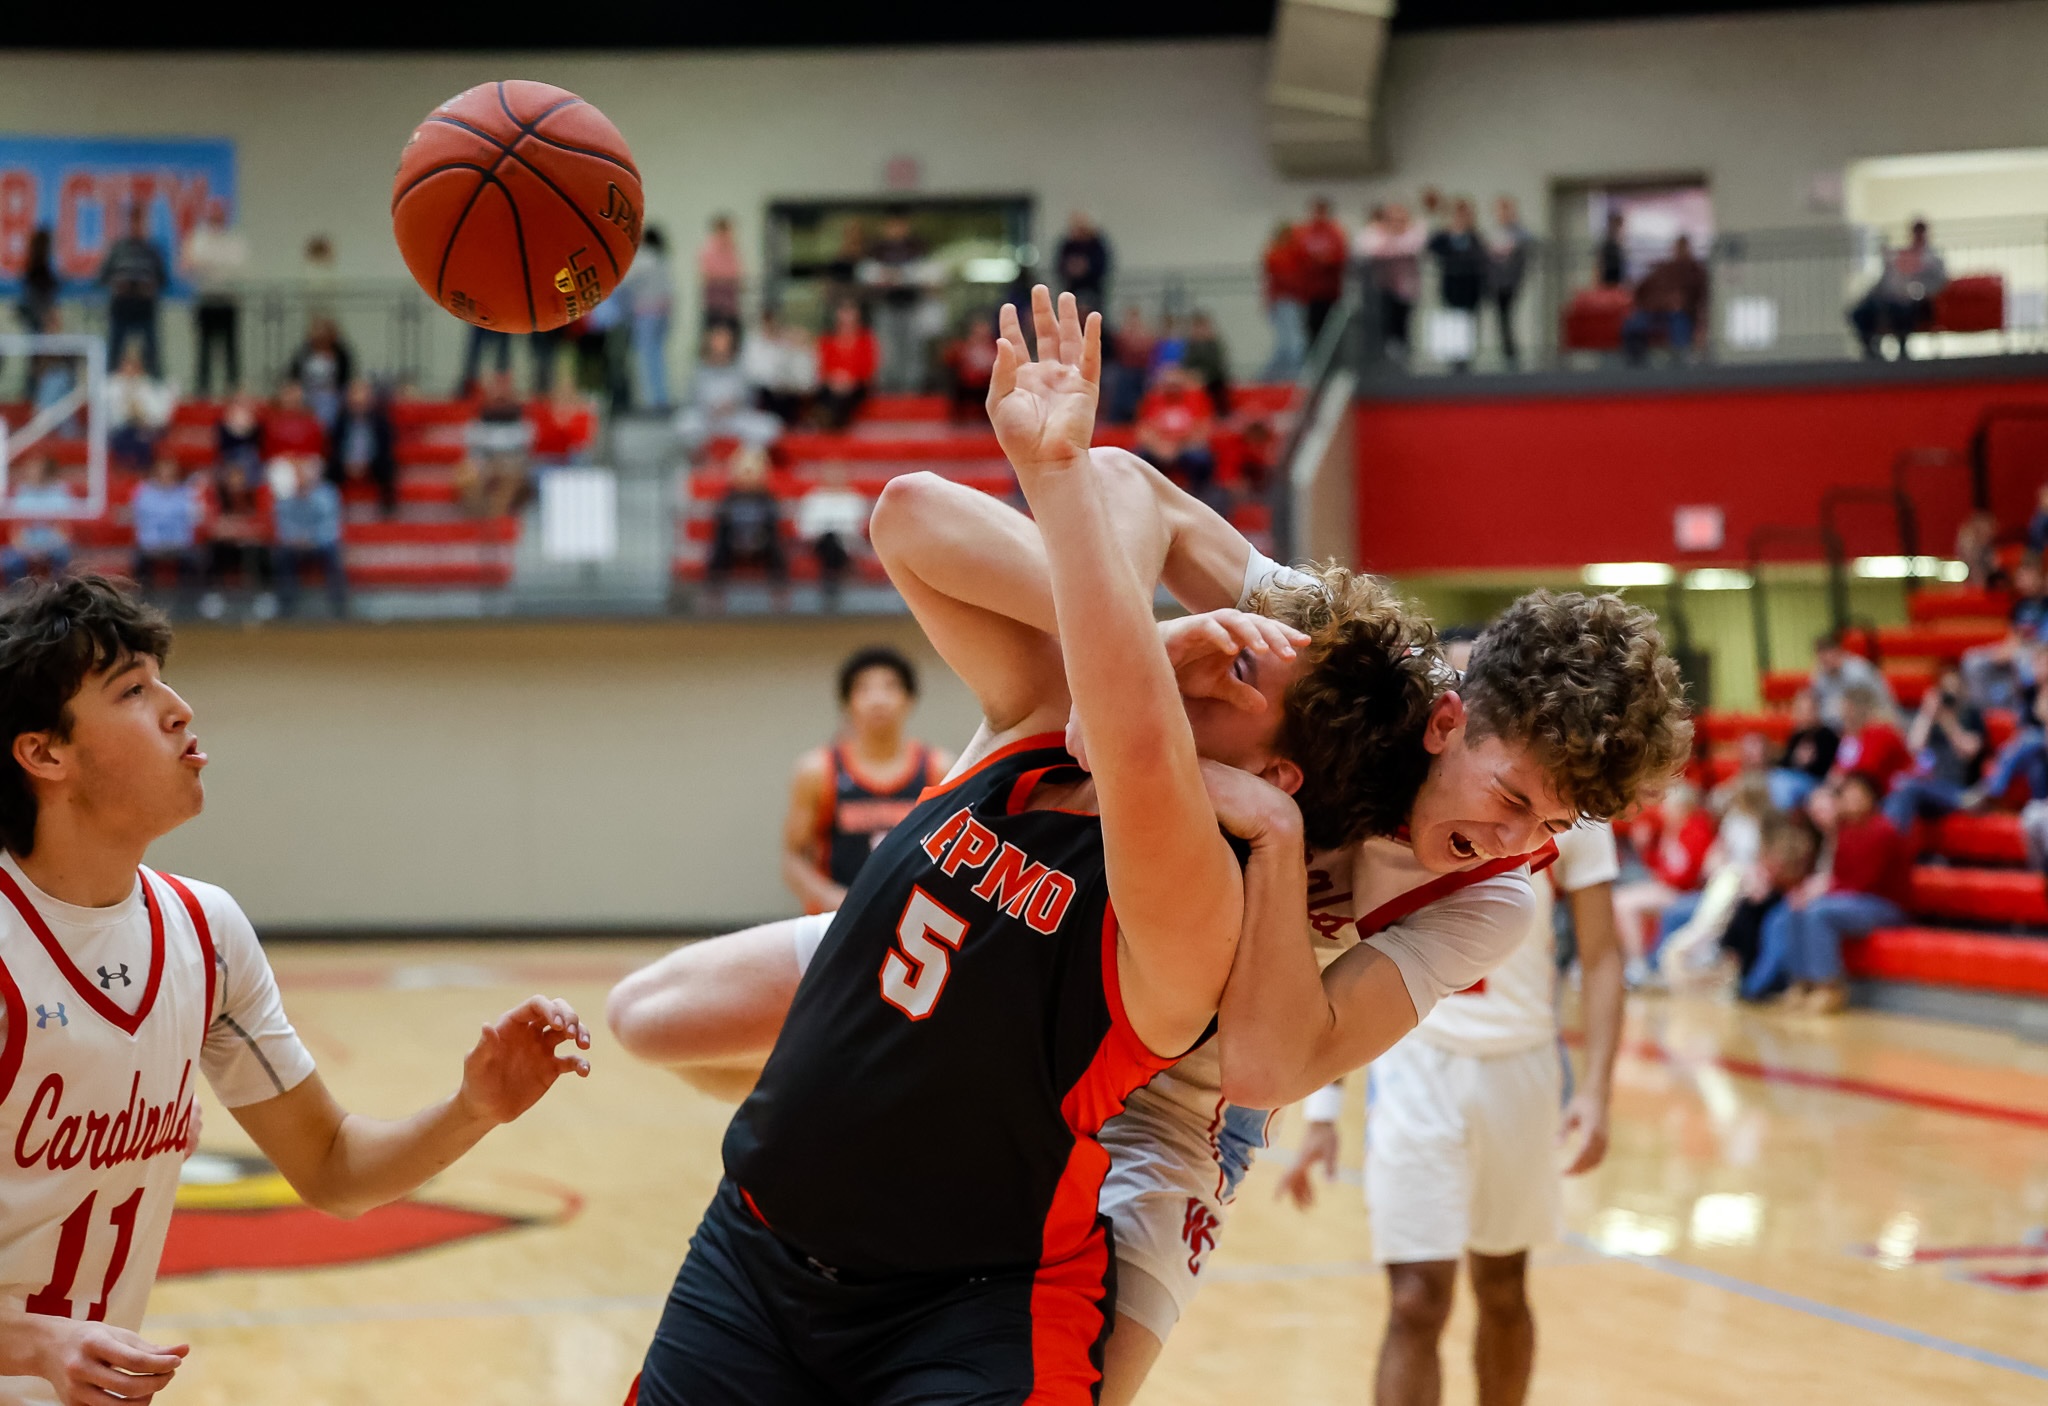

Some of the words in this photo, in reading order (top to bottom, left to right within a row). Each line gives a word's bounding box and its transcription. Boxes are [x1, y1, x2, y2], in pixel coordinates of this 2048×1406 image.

[920, 802, 1077, 935] APMO
[878, 883, 971, 1022] 5
[14, 1058, 194, 1171] Cardinals
[25, 1186, 145, 1323] 11
